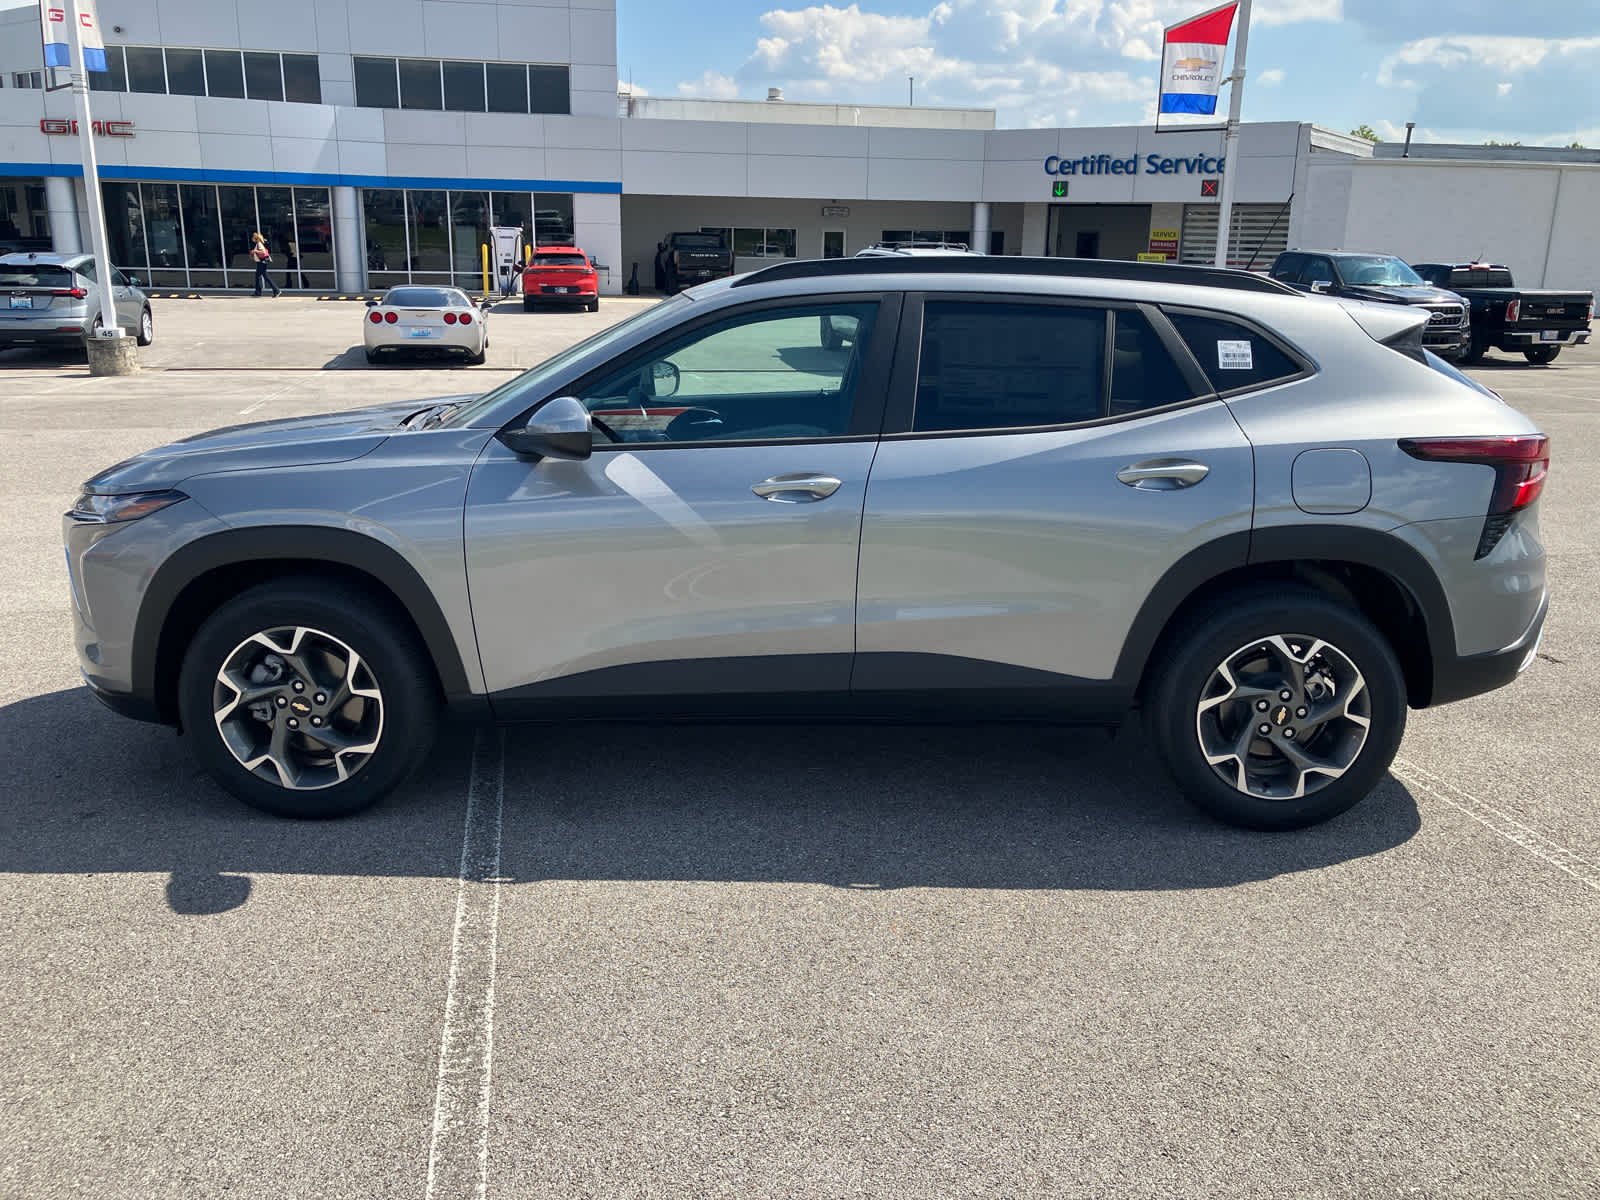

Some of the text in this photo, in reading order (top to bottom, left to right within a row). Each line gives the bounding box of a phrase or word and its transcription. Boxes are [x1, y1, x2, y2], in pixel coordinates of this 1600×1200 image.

[48, 8, 93, 27] GC
[1044, 153, 1138, 175] Certified
[101, 330, 113, 338] 45
